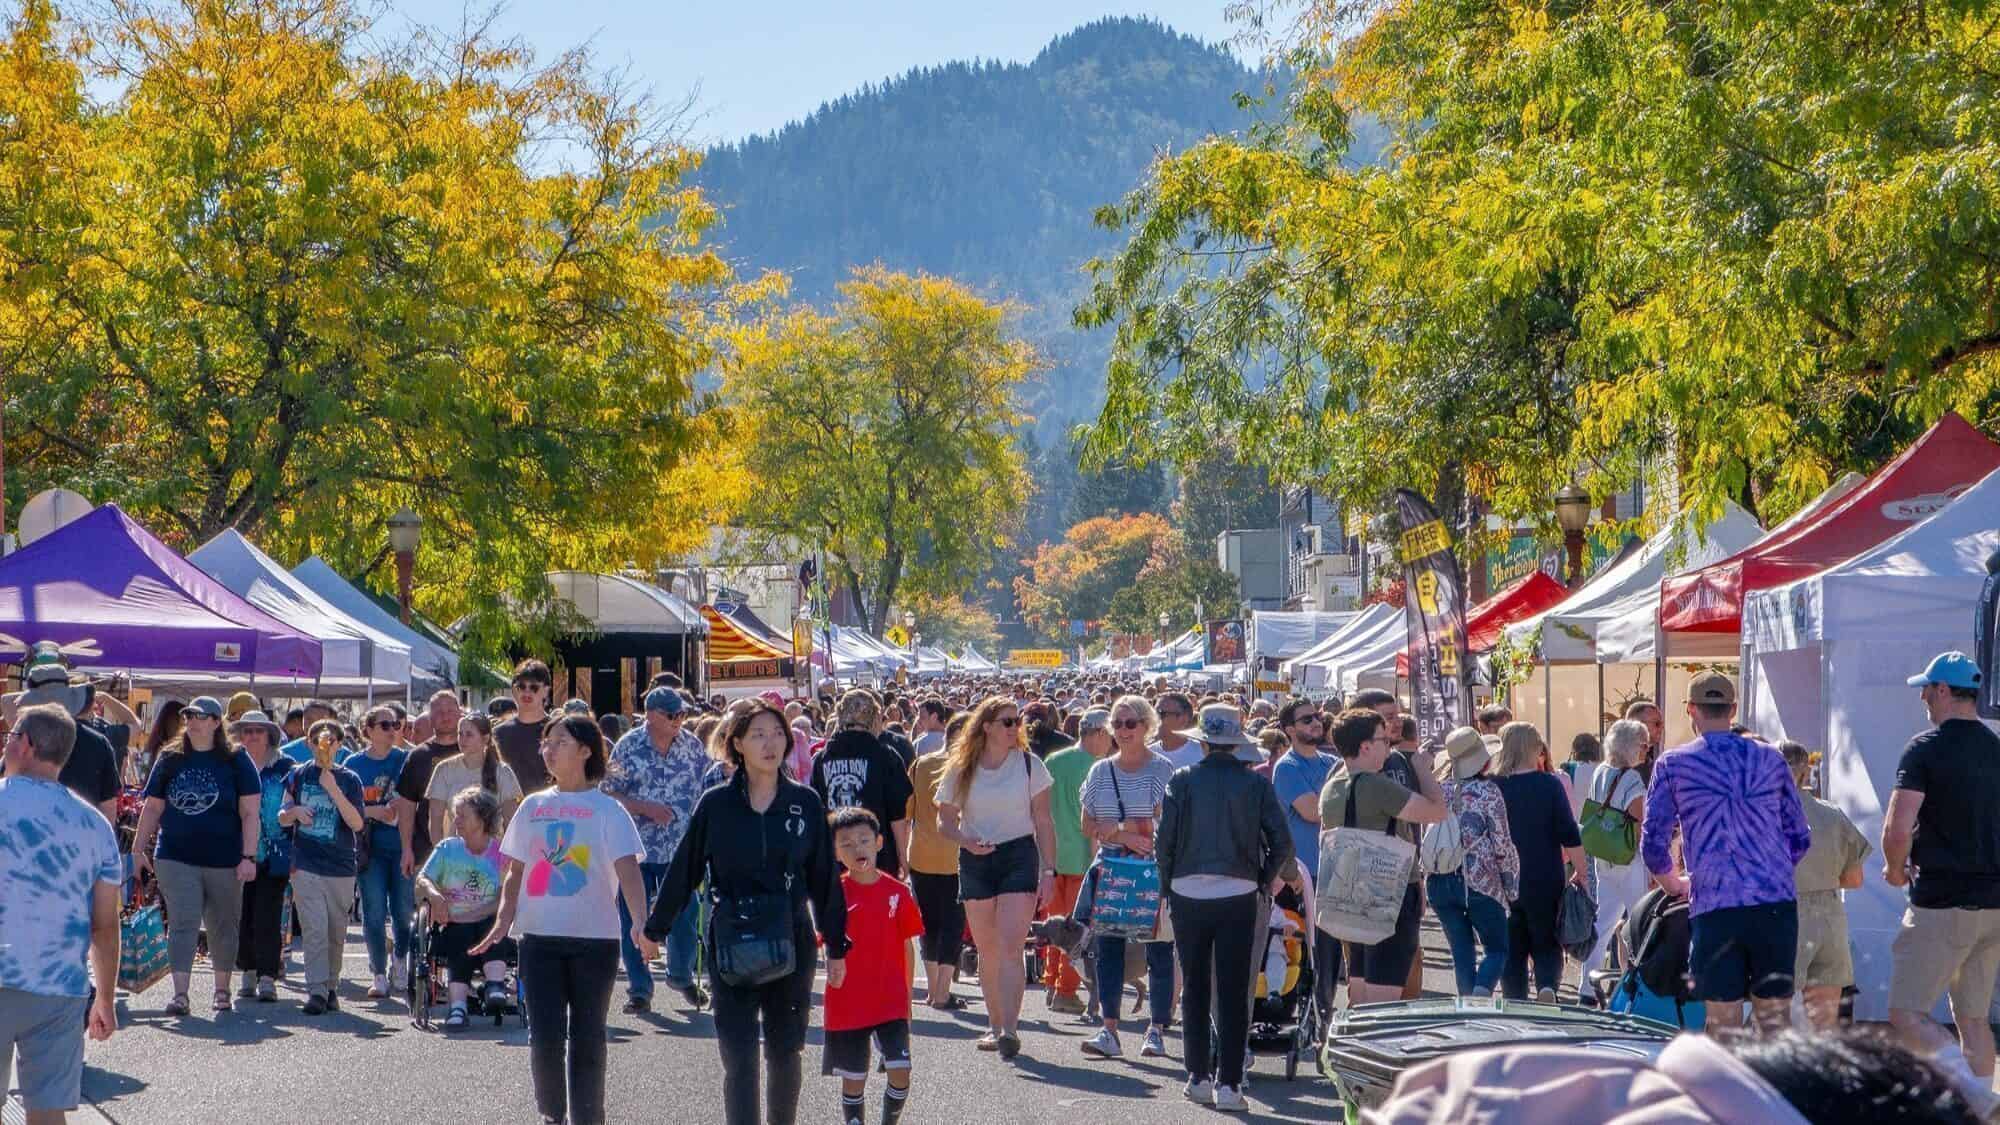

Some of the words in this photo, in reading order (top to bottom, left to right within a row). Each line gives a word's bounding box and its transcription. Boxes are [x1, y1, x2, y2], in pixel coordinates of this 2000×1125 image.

[1407, 525, 1438, 547] FREE
[1438, 622, 1459, 729] TRIST
[1419, 687, 1429, 714] YOU
